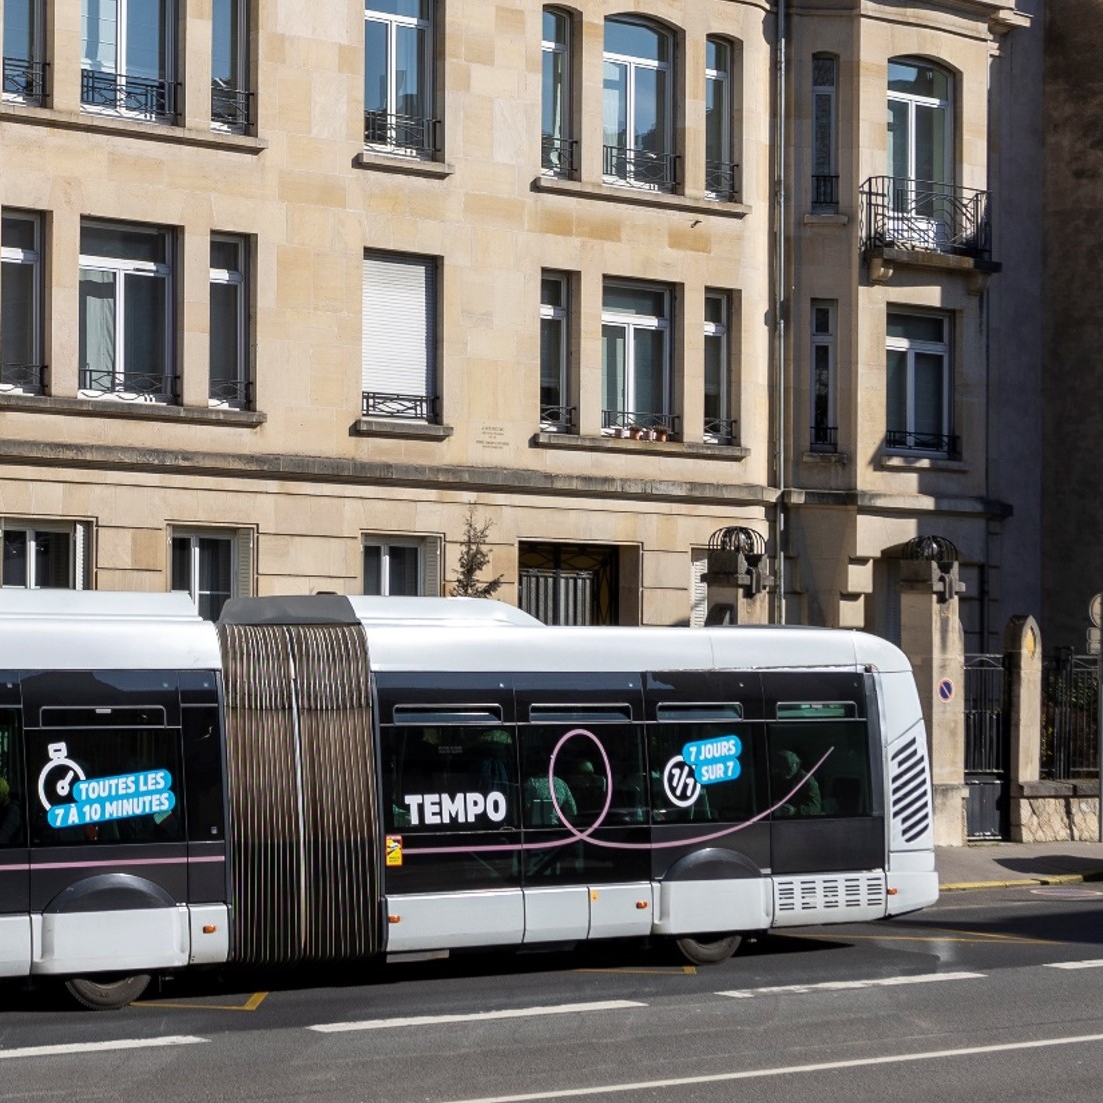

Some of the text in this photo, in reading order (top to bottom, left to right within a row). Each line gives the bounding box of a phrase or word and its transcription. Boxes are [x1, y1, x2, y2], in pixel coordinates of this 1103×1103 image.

[689, 739, 736, 762] 7 JOURS
[701, 761, 735, 781] SUR 7
[79, 772, 165, 800] TOUTES LES
[55, 792, 170, 826] 7 À 10 MINUTES
[404, 791, 507, 825] TEMPO
